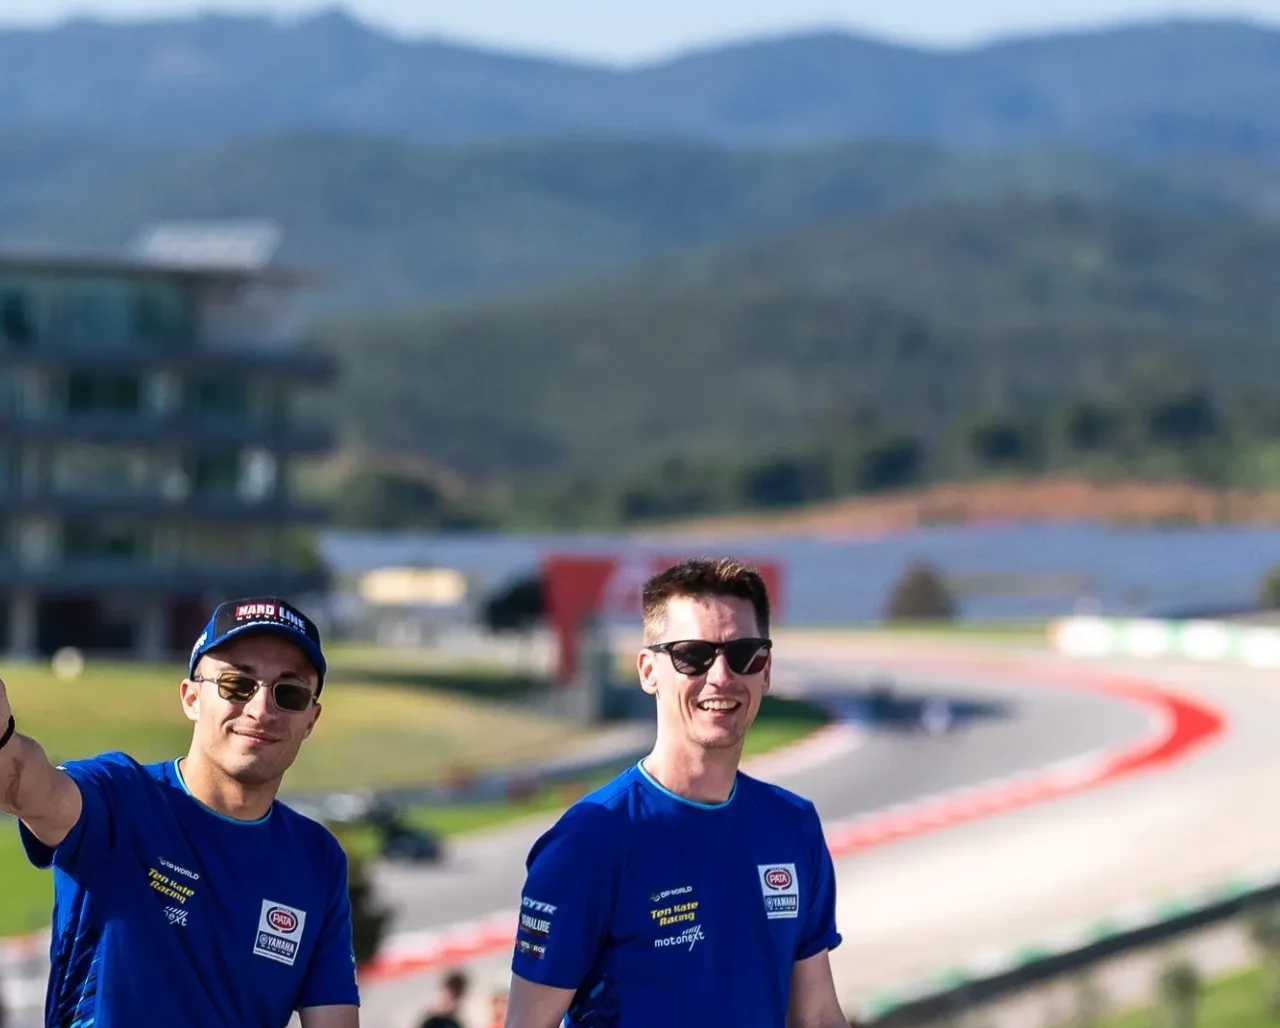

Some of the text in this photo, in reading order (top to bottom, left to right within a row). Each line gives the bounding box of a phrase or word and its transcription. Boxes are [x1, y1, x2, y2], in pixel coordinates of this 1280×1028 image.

[279, 606, 306, 630] LINE
[173, 865, 200, 880] WORLD
[769, 874, 788, 884] PATA
[148, 868, 195, 897] Ten Kate
[670, 885, 693, 896] WORLD
[150, 880, 186, 905] Racing
[522, 896, 558, 915] GYTR
[651, 901, 699, 919] Ten Kate
[272, 913, 293, 928] PATA
[660, 912, 696, 927] Racing
[267, 936, 296, 953] YAMAHA
[654, 924, 705, 952] motonext
